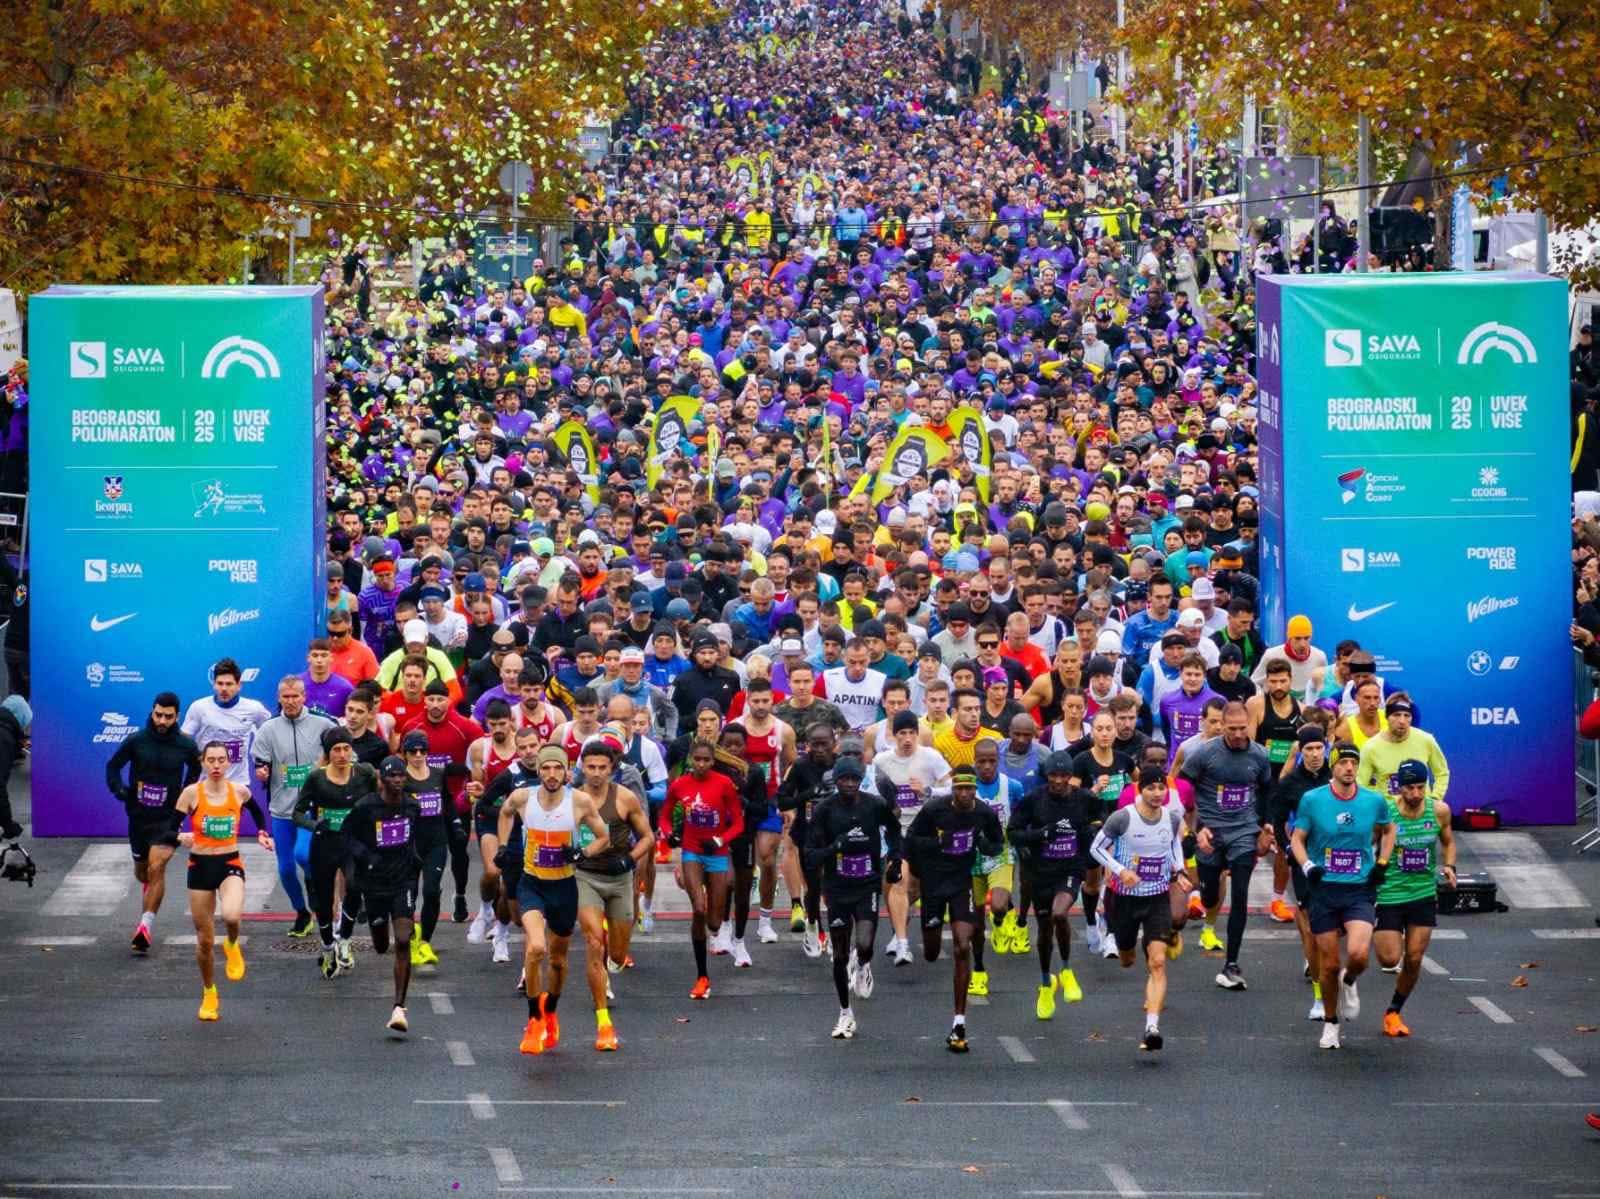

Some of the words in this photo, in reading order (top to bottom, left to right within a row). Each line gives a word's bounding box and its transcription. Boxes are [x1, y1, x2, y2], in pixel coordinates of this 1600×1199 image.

[1368, 335, 1421, 351] SAVA
[113, 347, 164, 365] SAVA
[1327, 397, 1417, 414] BEOGRADSKI
[1451, 396, 1472, 412] 20
[1490, 395, 1528, 411] UVEK
[71, 409, 161, 426] BEOGRADSKI
[194, 409, 215, 425] 20
[232, 409, 271, 425] UVEK
[1327, 414, 1432, 431] POLUMARATON
[1451, 413, 1472, 429] 25
[71, 426, 175, 443] POLUMARATON
[194, 426, 215, 442] 25
[1367, 551, 1401, 563] SAVA
[1467, 547, 1517, 559] POWER
[110, 562, 143, 574] SAVA
[208, 559, 258, 571] POWER
[1489, 559, 1517, 570] ADE
[1467, 595, 1520, 623] Wellness
[208, 606, 261, 635] Wellness
[833, 693, 876, 706] APATIN
[1049, 842, 1073, 851] PACER
